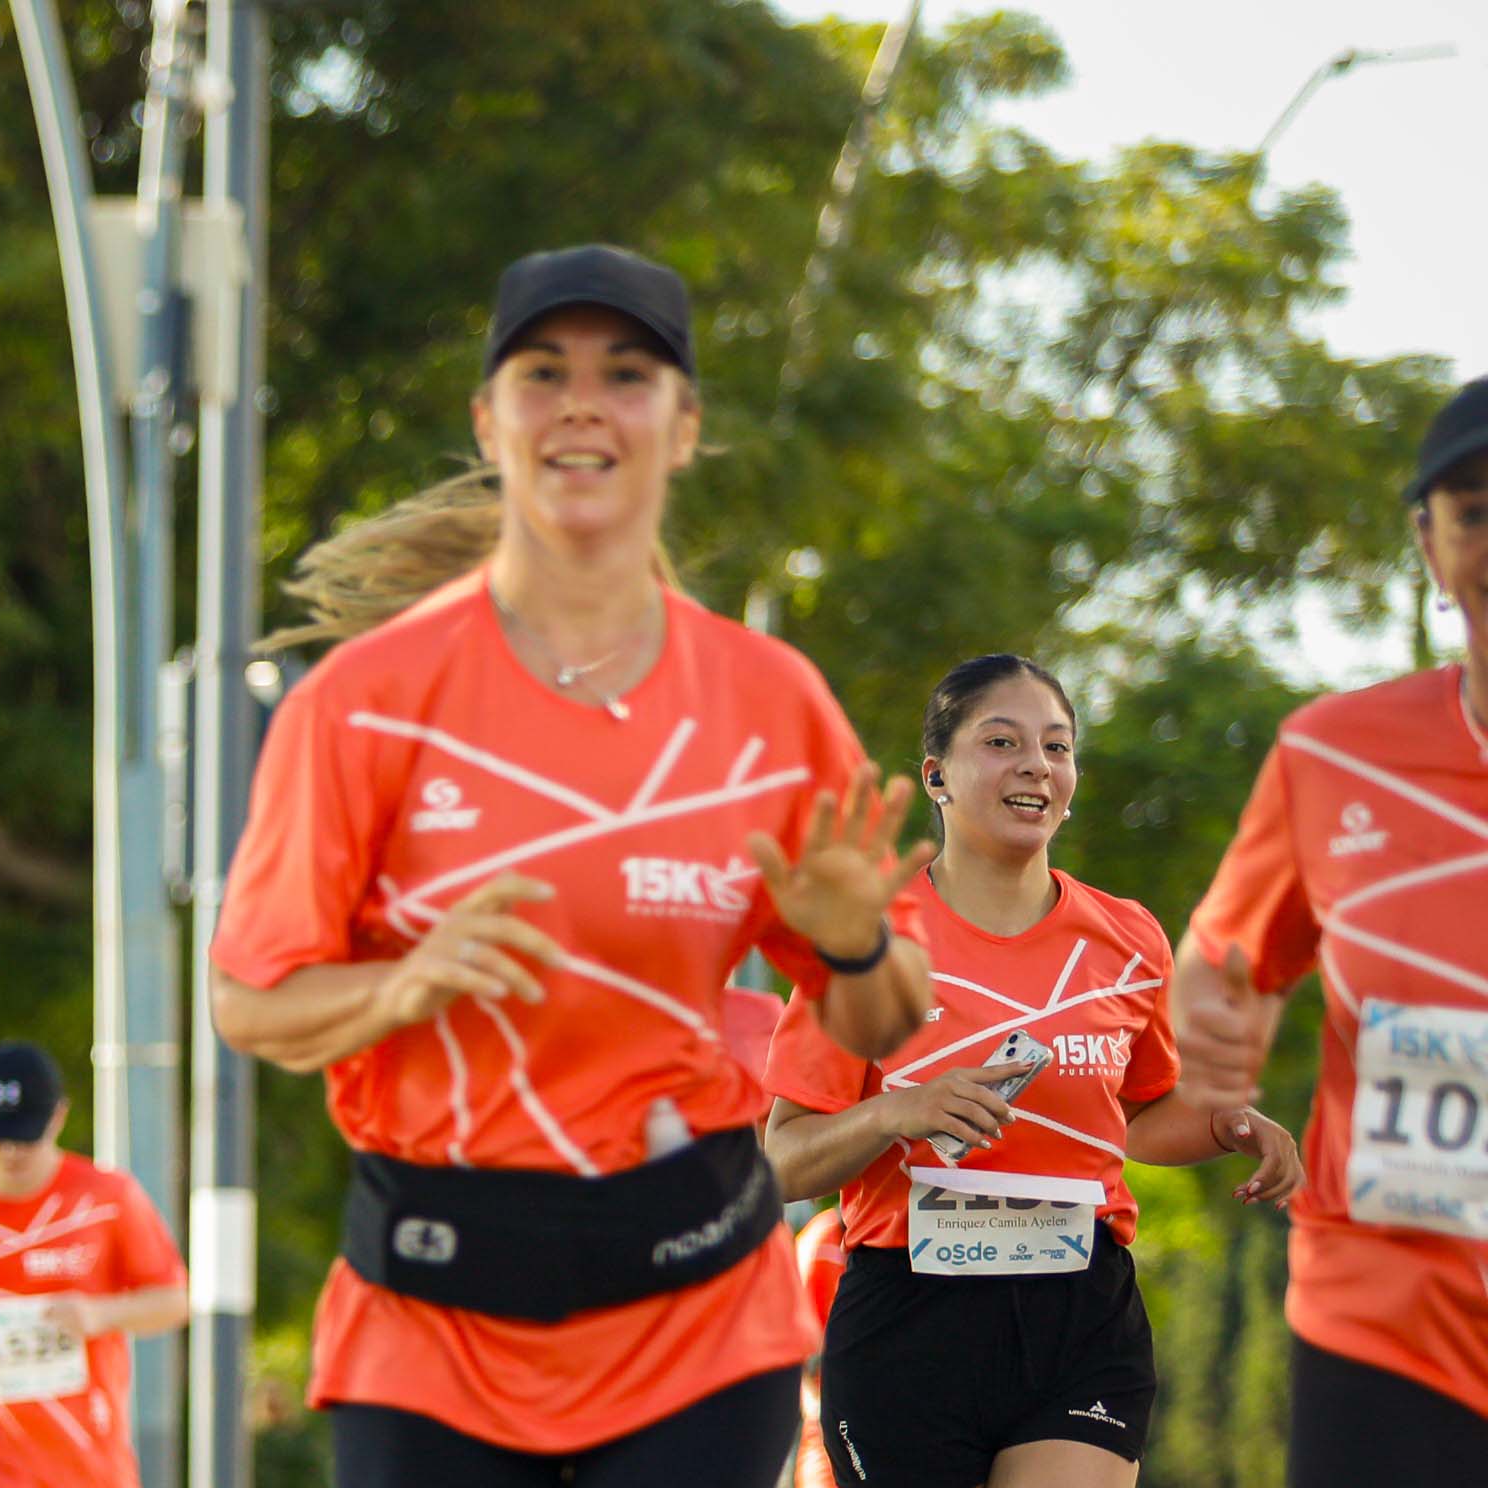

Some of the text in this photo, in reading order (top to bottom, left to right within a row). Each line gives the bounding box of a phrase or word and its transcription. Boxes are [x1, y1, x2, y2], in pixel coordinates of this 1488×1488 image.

[620, 857, 706, 904] 15K
[1053, 1034, 1107, 1066] 15K
[1366, 1076, 1488, 1152] 10
[937, 1215, 1067, 1231] Enriquez Camila Ayelen
[936, 1241, 998, 1266] osde
